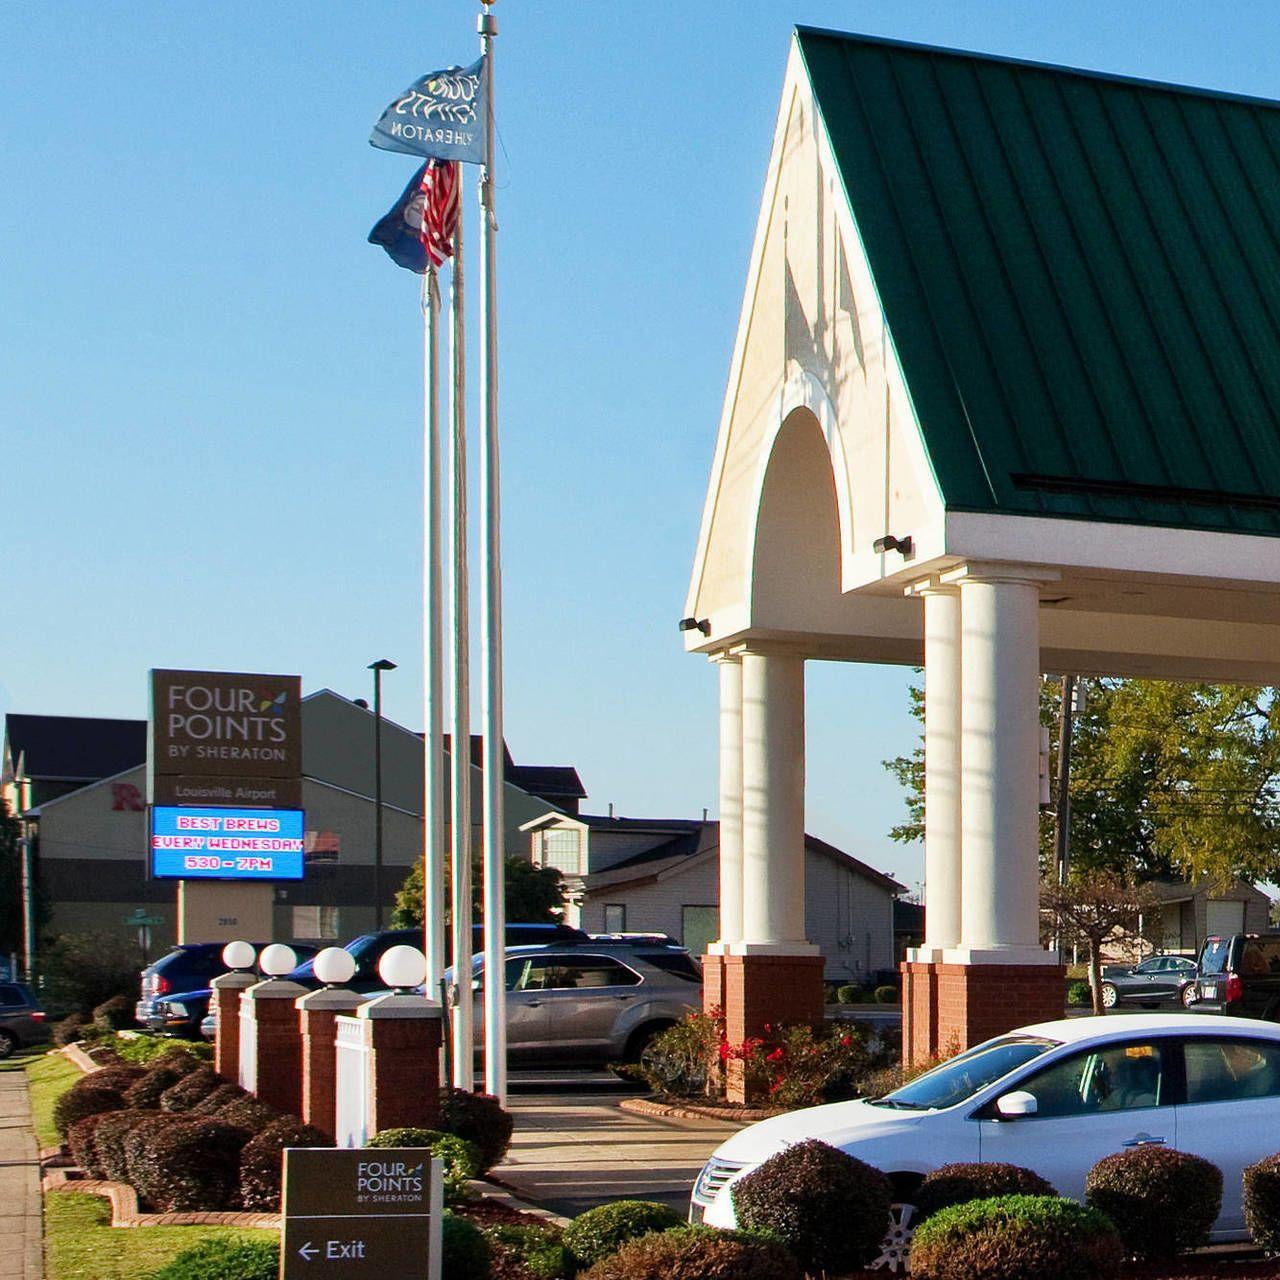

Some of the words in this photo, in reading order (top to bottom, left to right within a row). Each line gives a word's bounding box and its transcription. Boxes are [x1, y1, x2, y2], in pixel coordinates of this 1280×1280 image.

[169, 686, 258, 713] FOUR
[169, 714, 286, 742] POINTS
[169, 745, 189, 758] BY
[197, 746, 285, 760] SHERATON
[175, 785, 233, 798] Louisville
[235, 787, 276, 800] Airport
[178, 816, 220, 830] BEST
[225, 818, 279, 832] BREWS
[152, 836, 204, 848] EVERY
[208, 838, 304, 851] WEDNESDAY
[186, 857, 220, 869] 530
[237, 858, 271, 870] 7PM
[358, 1163, 406, 1176] FOUR
[357, 1177, 422, 1192] POINTS
[372, 1194, 422, 1202] SHERATON
[327, 1240, 365, 1259] Exit
